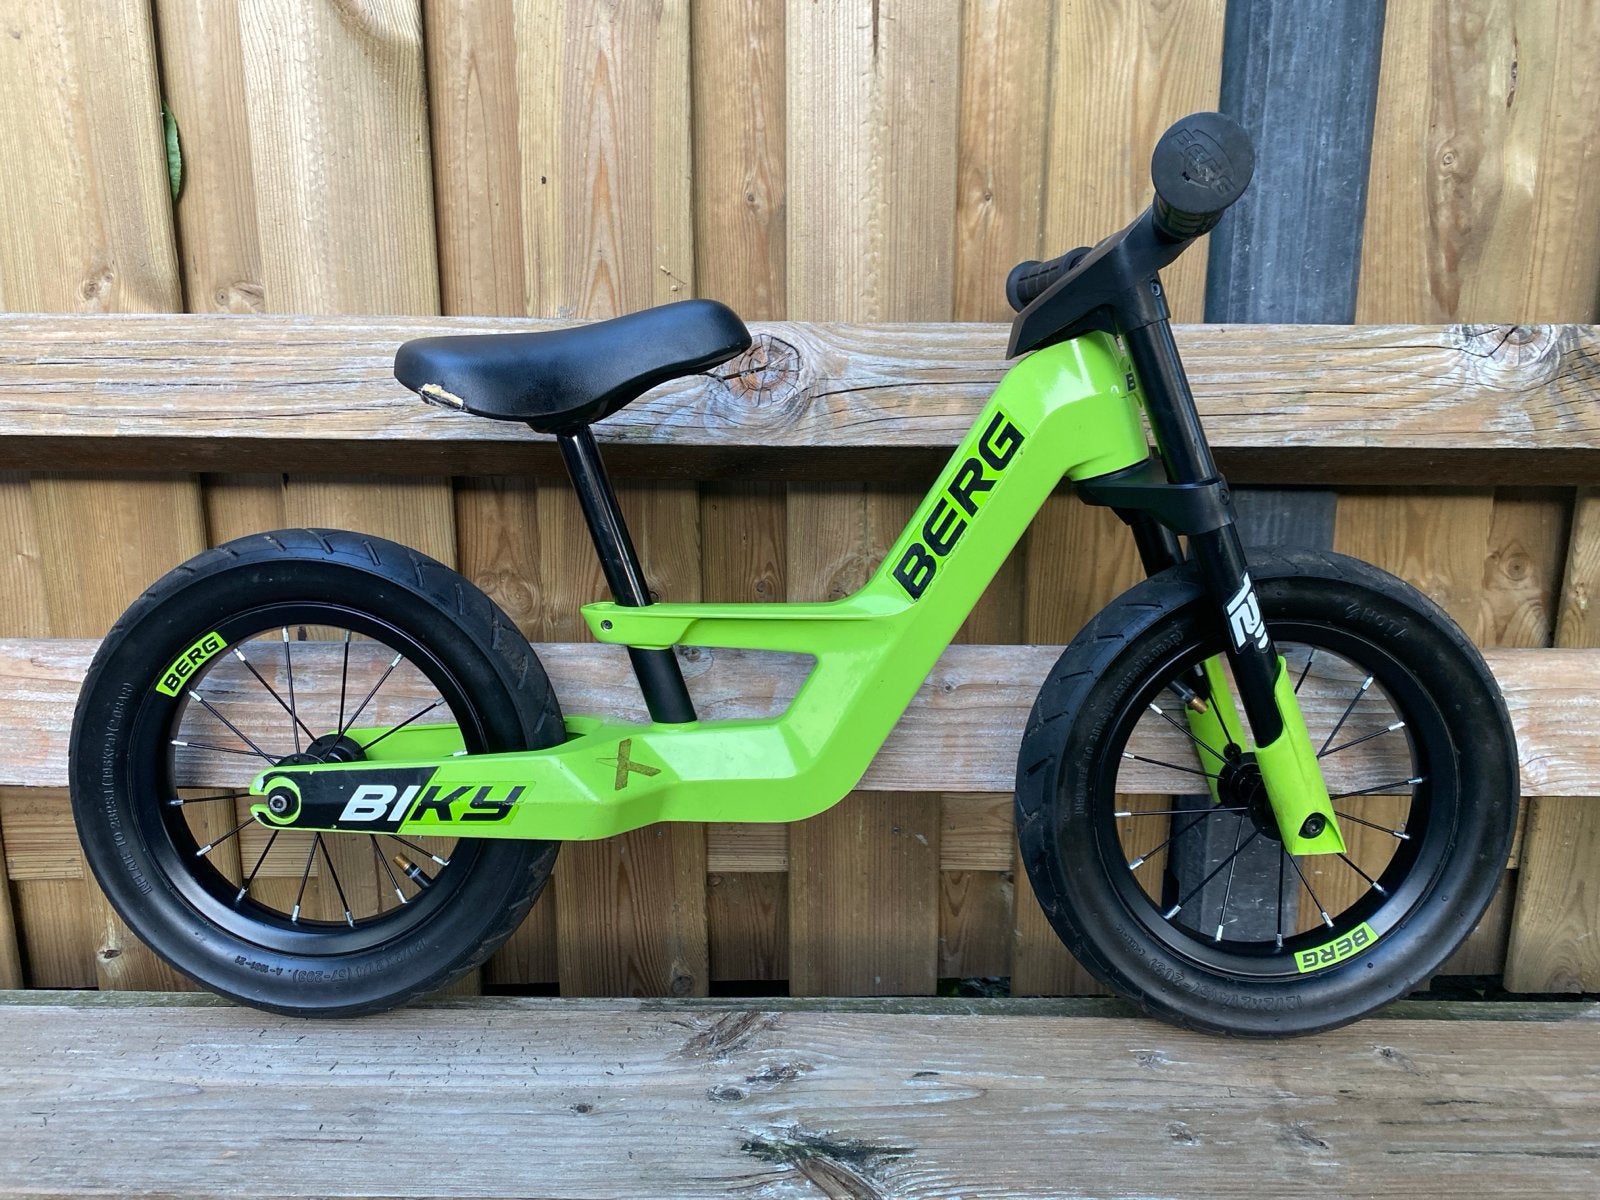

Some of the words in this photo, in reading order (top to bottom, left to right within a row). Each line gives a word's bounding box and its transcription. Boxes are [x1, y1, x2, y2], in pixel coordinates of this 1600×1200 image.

[892, 410, 1025, 602] BERG
[163, 635, 220, 693] BERG
[337, 784, 527, 822] BIKY
[1302, 927, 1370, 969] BERG
